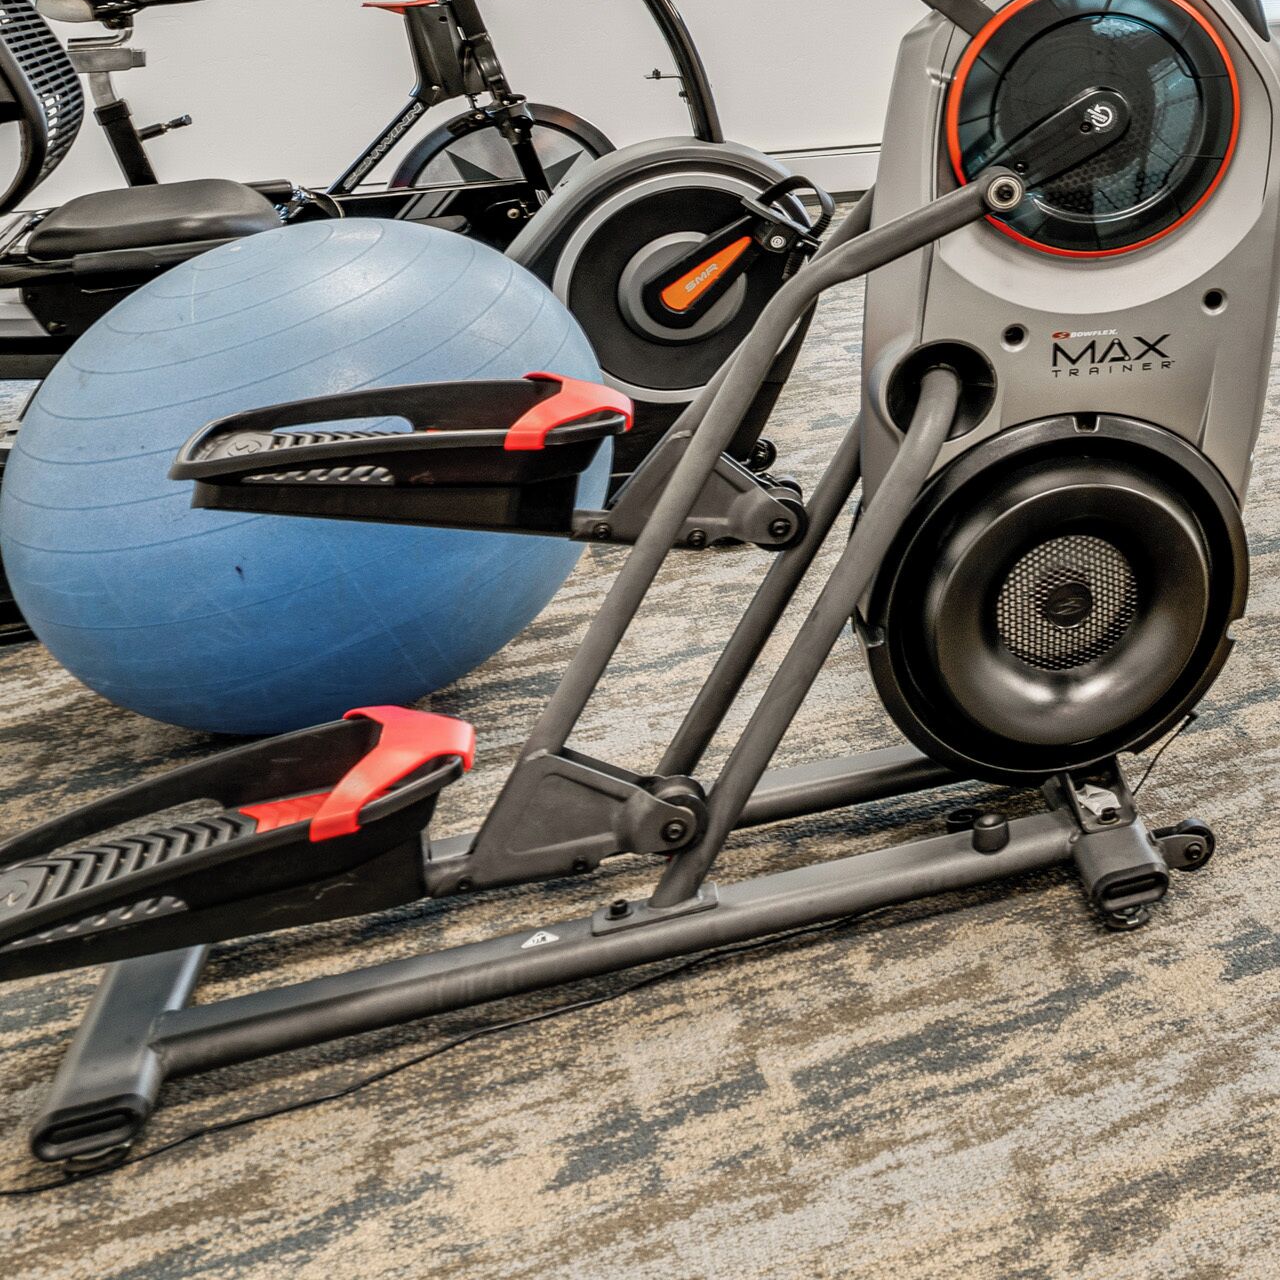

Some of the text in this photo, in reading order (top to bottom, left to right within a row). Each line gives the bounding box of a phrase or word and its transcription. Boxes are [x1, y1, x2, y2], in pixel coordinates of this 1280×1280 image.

[343, 102, 424, 190] SCHWINN
[1070, 329, 1118, 338] BOWFLEX
[1052, 333, 1171, 367] MAX
[1052, 361, 1172, 378] TRAINER
